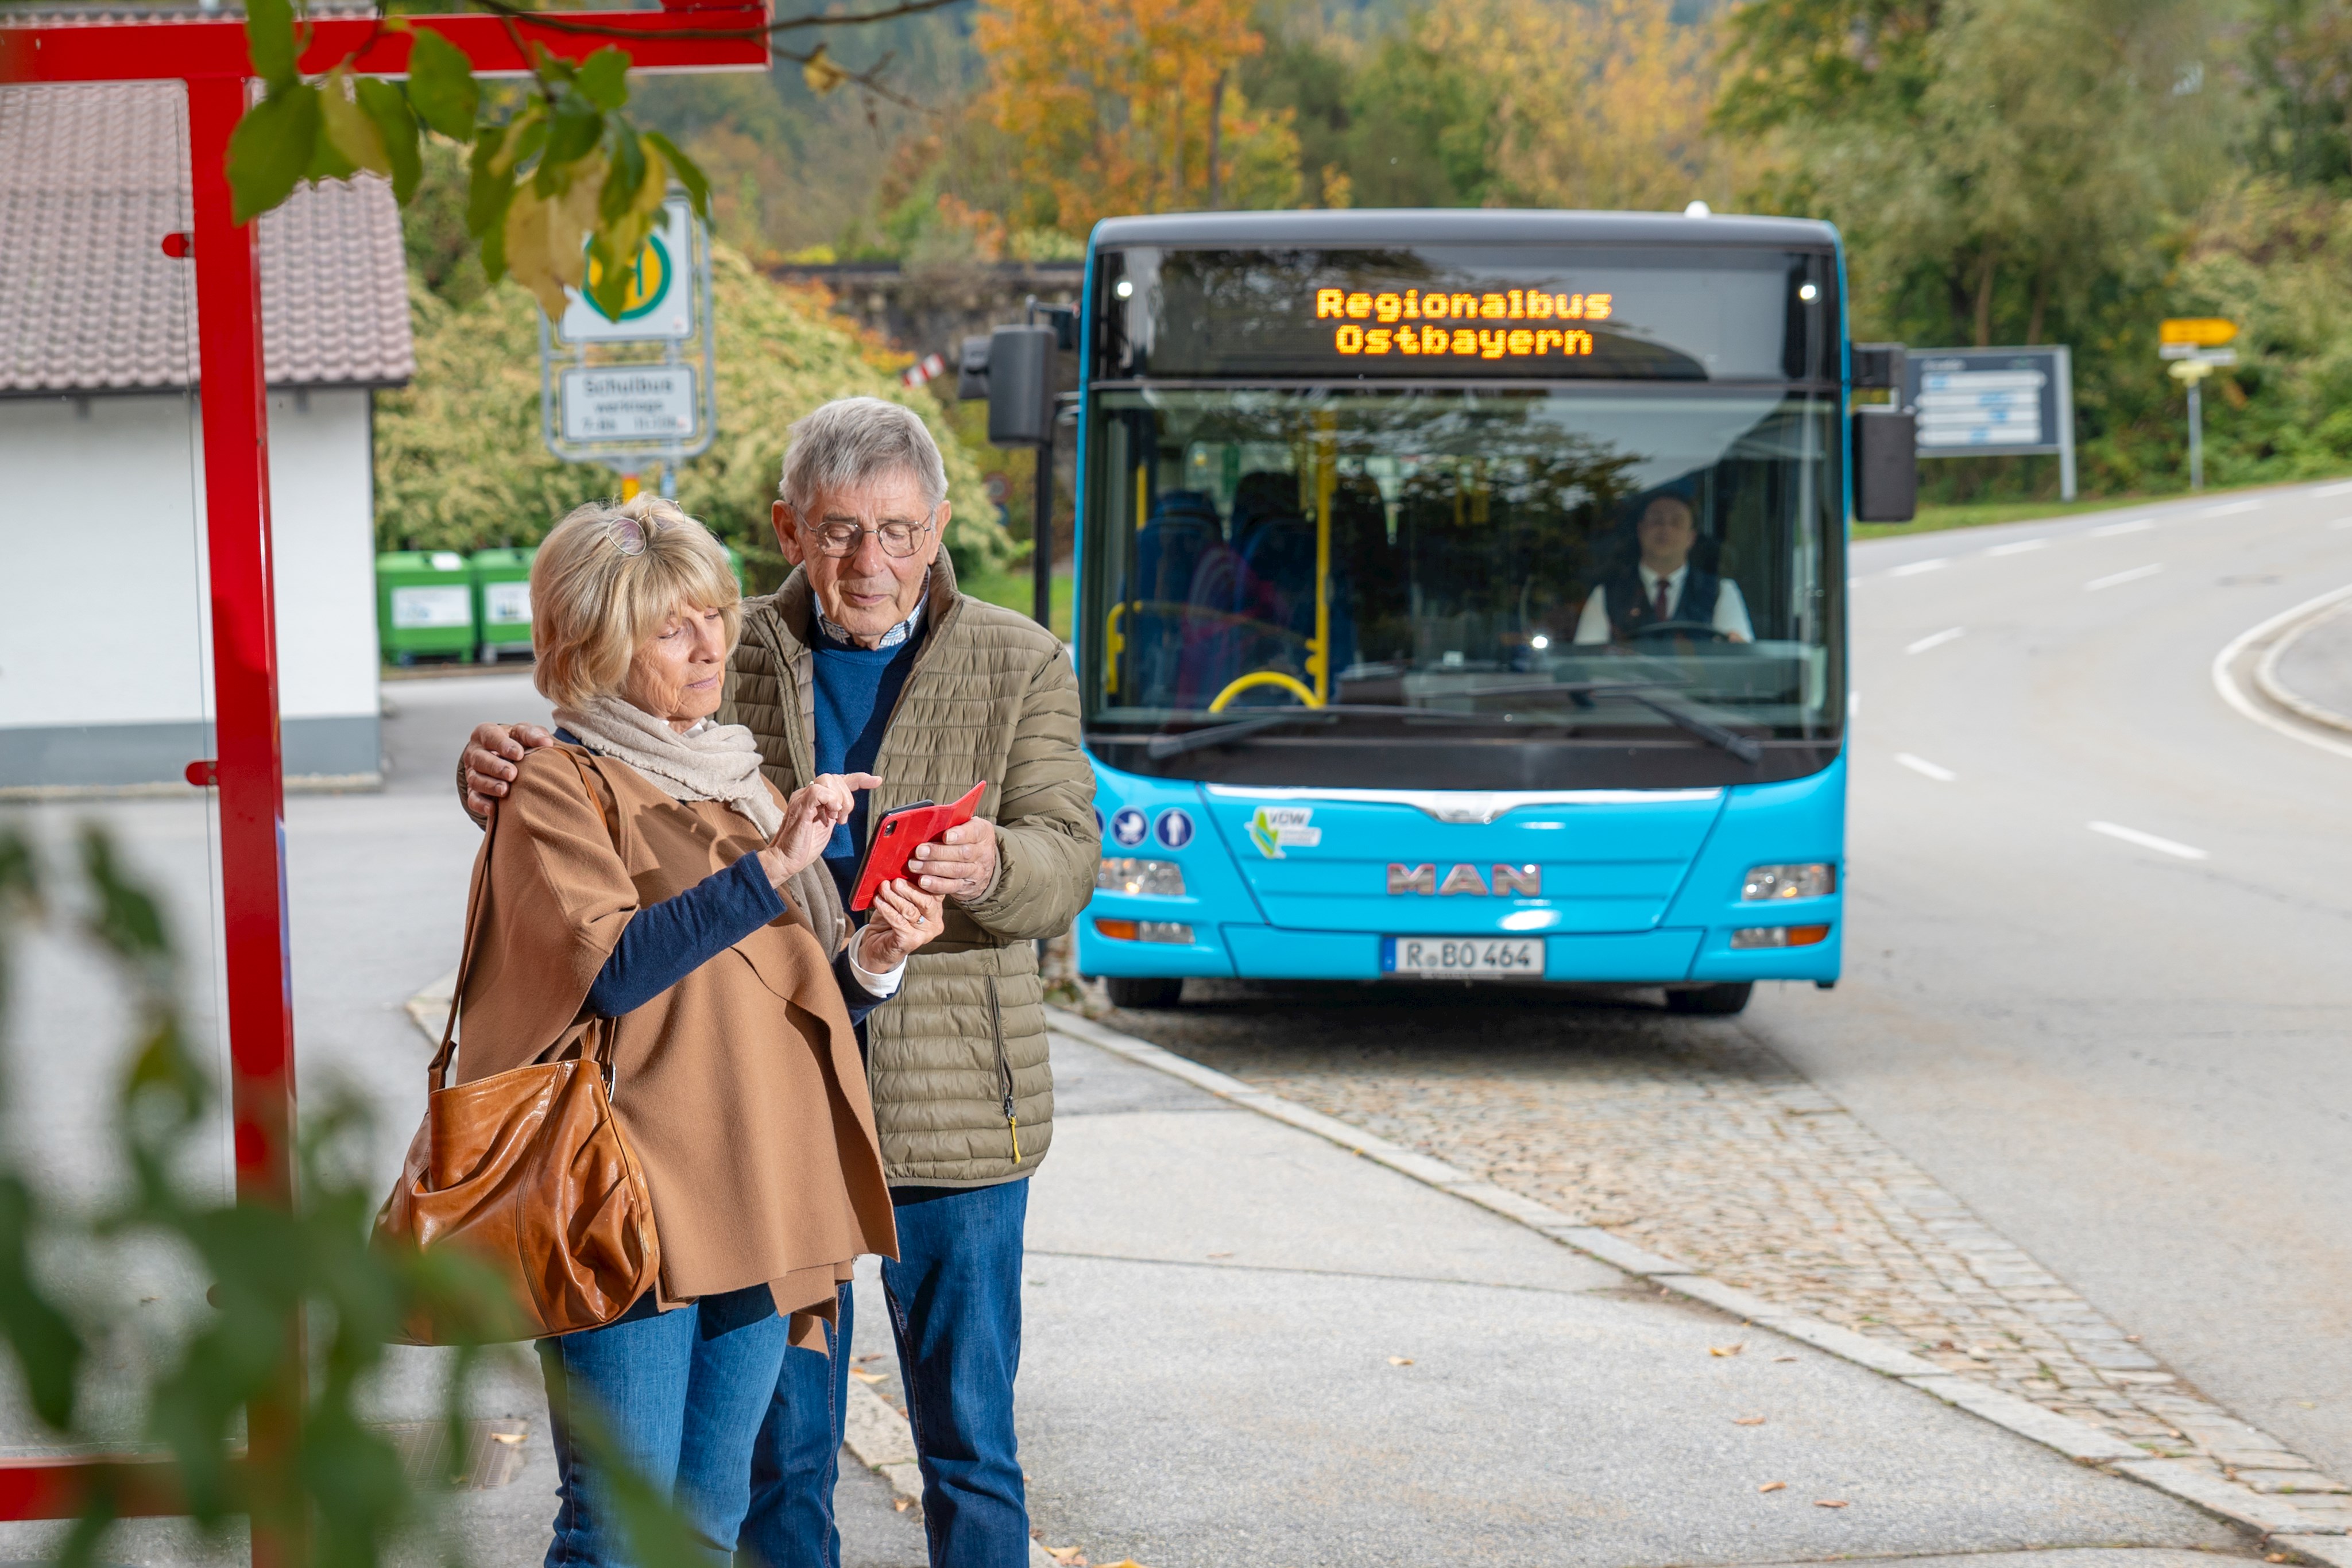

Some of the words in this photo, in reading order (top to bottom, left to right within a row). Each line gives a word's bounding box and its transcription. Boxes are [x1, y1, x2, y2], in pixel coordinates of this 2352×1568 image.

[1317, 289, 1612, 323] Regionalbus
[1335, 324, 1593, 359] Ostbayern
[583, 377, 674, 396] Schulbus
[1387, 863, 1541, 896] MAN
[1407, 943, 1422, 967] R
[1442, 943, 1476, 967] BO
[1483, 942, 1530, 967] 464
